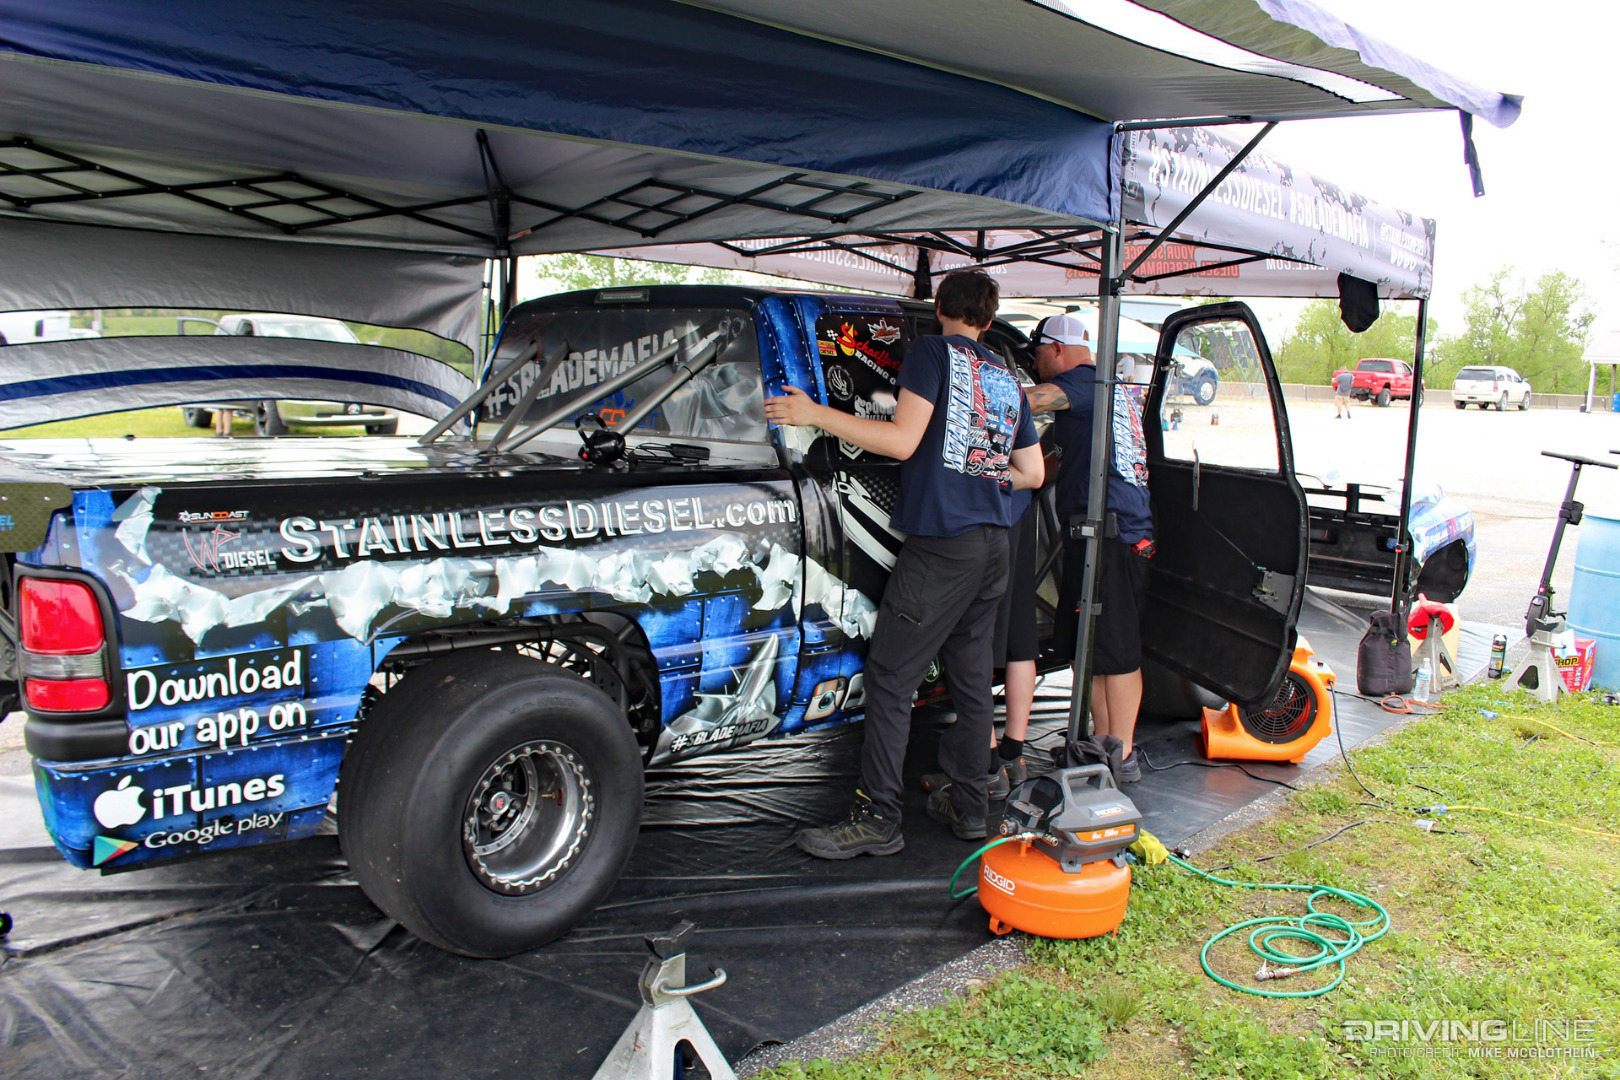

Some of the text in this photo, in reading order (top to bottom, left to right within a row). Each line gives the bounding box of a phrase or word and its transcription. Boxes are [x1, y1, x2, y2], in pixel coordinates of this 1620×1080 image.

[855, 349, 890, 379] RACING
[189, 510, 250, 520] SUNCOAST
[219, 549, 276, 569] DIESEL
[126, 649, 303, 711] Download
[128, 701, 307, 755] our app on
[152, 773, 286, 821] iTunes
[144, 811, 284, 849] Google play
[983, 864, 1016, 891] RIDGID
